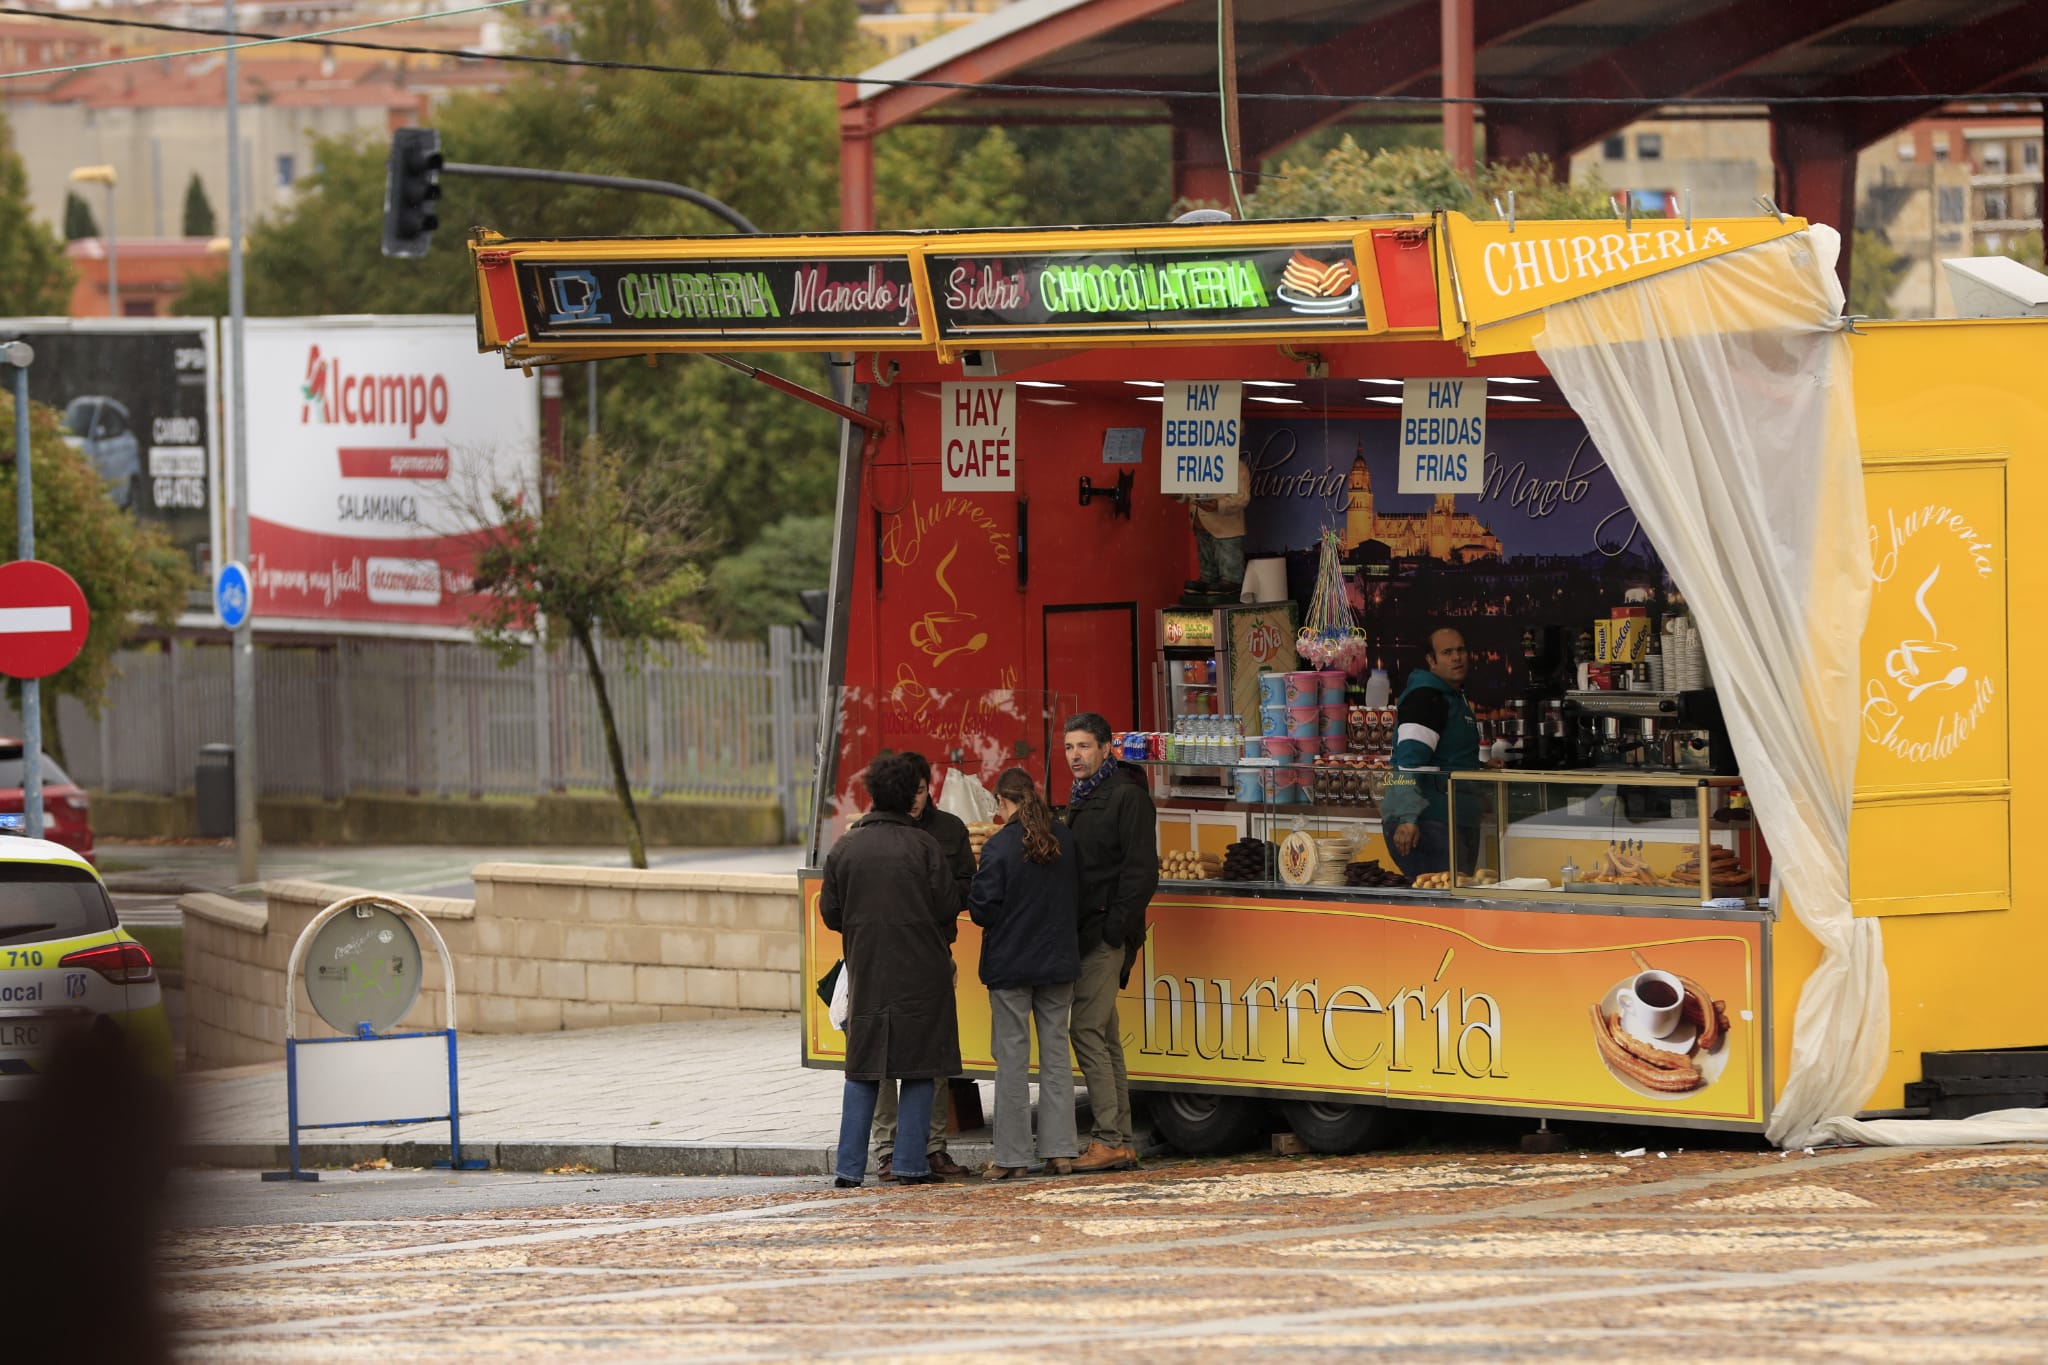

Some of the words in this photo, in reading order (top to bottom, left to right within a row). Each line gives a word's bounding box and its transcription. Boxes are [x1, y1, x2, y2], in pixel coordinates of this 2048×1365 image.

[618, 271, 780, 318] CHURRERIA
[789, 262, 897, 316] Manolo
[898, 281, 917, 327] y
[1040, 259, 1269, 313] CHOCOLATERIA
[302, 344, 449, 439] Alcampo
[1186, 384, 1220, 411] HAY
[1427, 381, 1464, 409] HAY
[954, 388, 1004, 427] HAY
[1165, 419, 1237, 447] BEBIDAS
[1405, 417, 1482, 446] BEBIDAS
[946, 426, 1011, 479] CAFÉ
[1176, 455, 1225, 483] FRIAS
[1240, 428, 1355, 512] hurrería
[1478, 433, 1606, 518] Manolo
[1415, 453, 1468, 482] FRIAS
[337, 494, 417, 521] SALAMANCA
[7, 950, 43, 967] 710
[0, 982, 42, 1001] ocal
[1121, 919, 1510, 1079] hurrería
